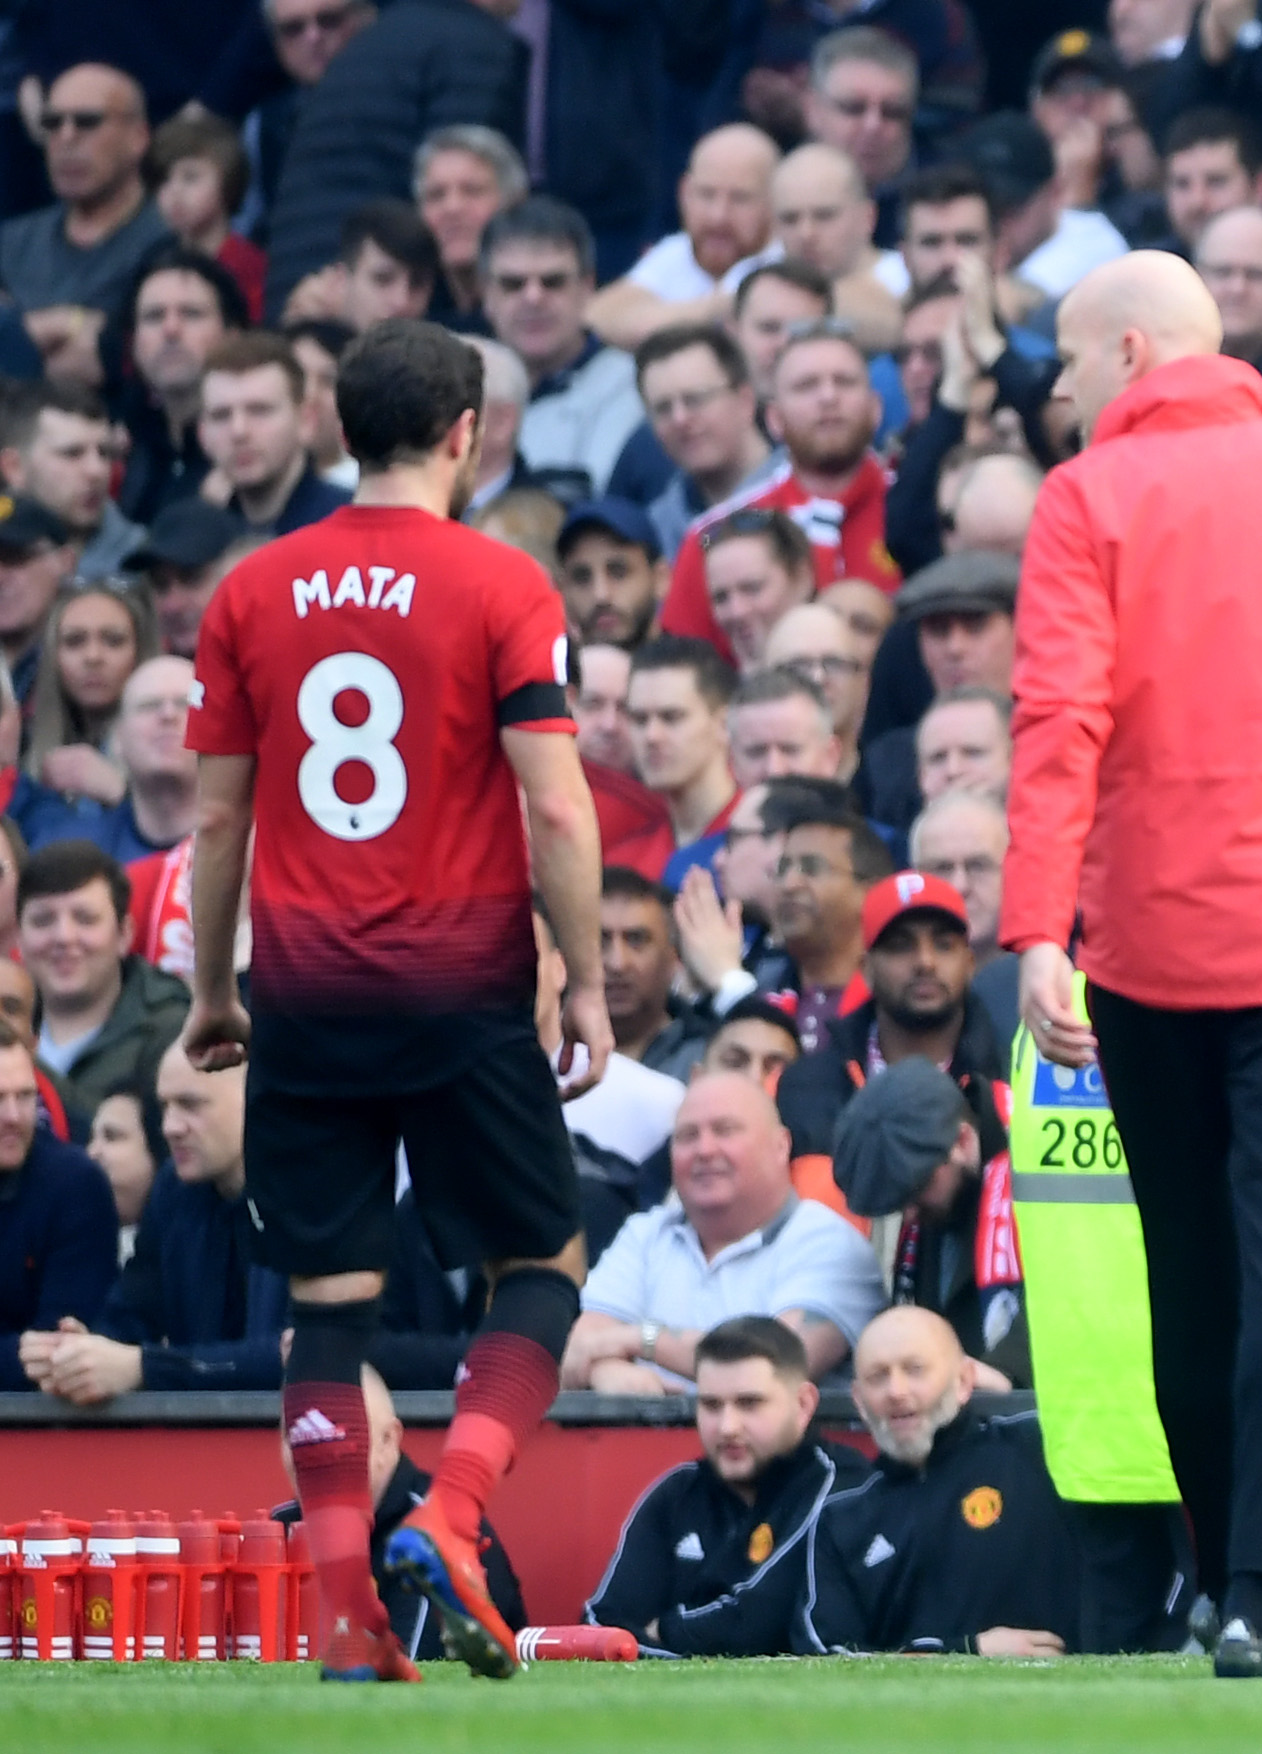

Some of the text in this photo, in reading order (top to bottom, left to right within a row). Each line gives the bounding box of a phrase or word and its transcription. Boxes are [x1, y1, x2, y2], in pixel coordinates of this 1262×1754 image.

[292, 565, 416, 619] MATA
[296, 651, 408, 842] 8
[1039, 1118, 1123, 1168] 286
